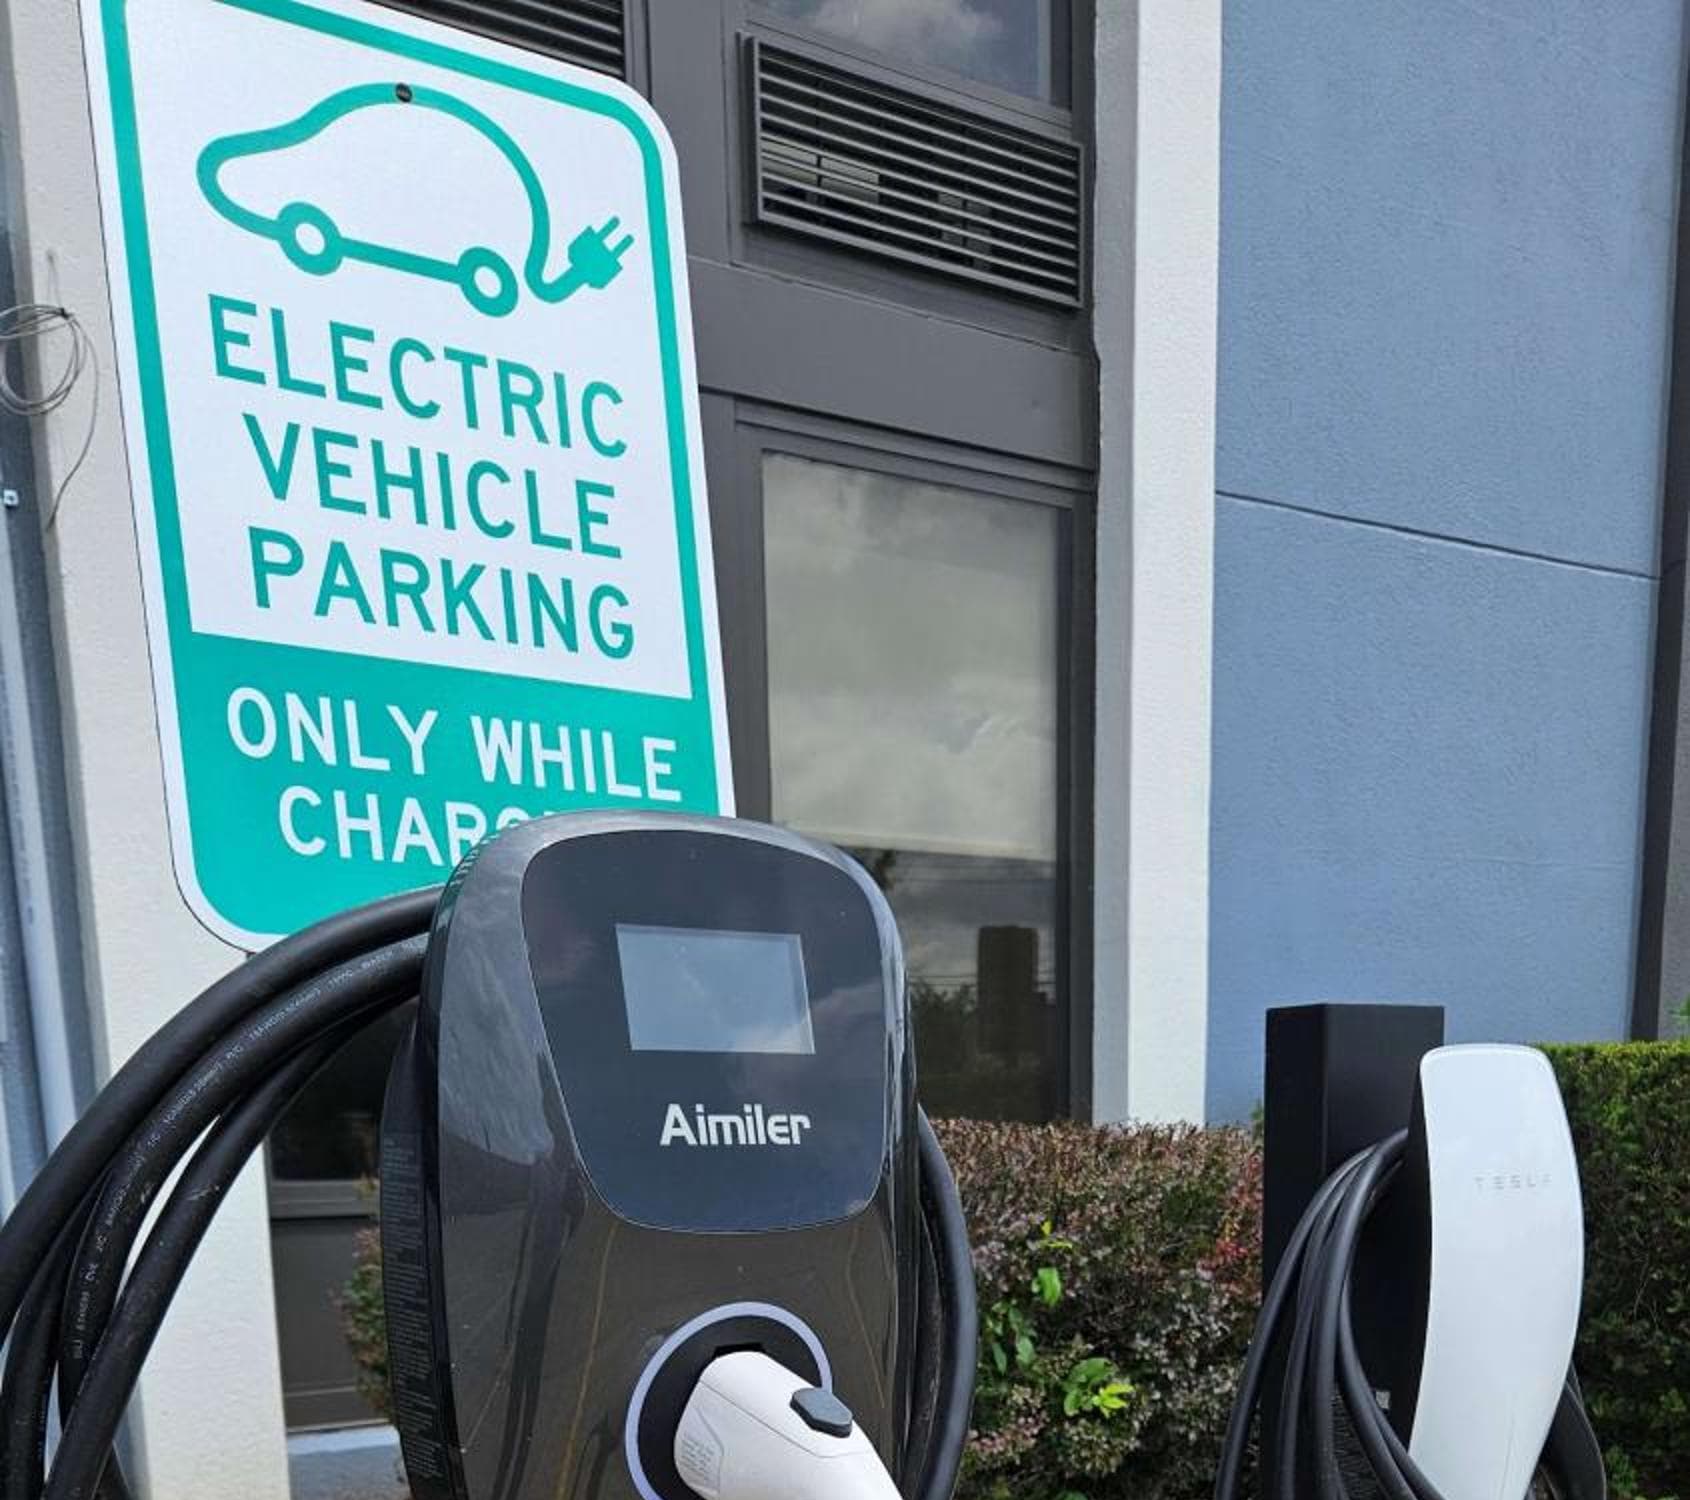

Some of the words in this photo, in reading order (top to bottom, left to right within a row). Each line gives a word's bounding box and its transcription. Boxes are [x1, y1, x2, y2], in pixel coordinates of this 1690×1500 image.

[208, 293, 627, 459] ELECTRIC
[242, 413, 622, 559] VEHICLE
[247, 526, 635, 661] PARKING
[226, 686, 437, 776] ONLY
[471, 715, 681, 802] WHILE
[279, 785, 556, 868] CHAR
[659, 1103, 812, 1146] Aimiler
